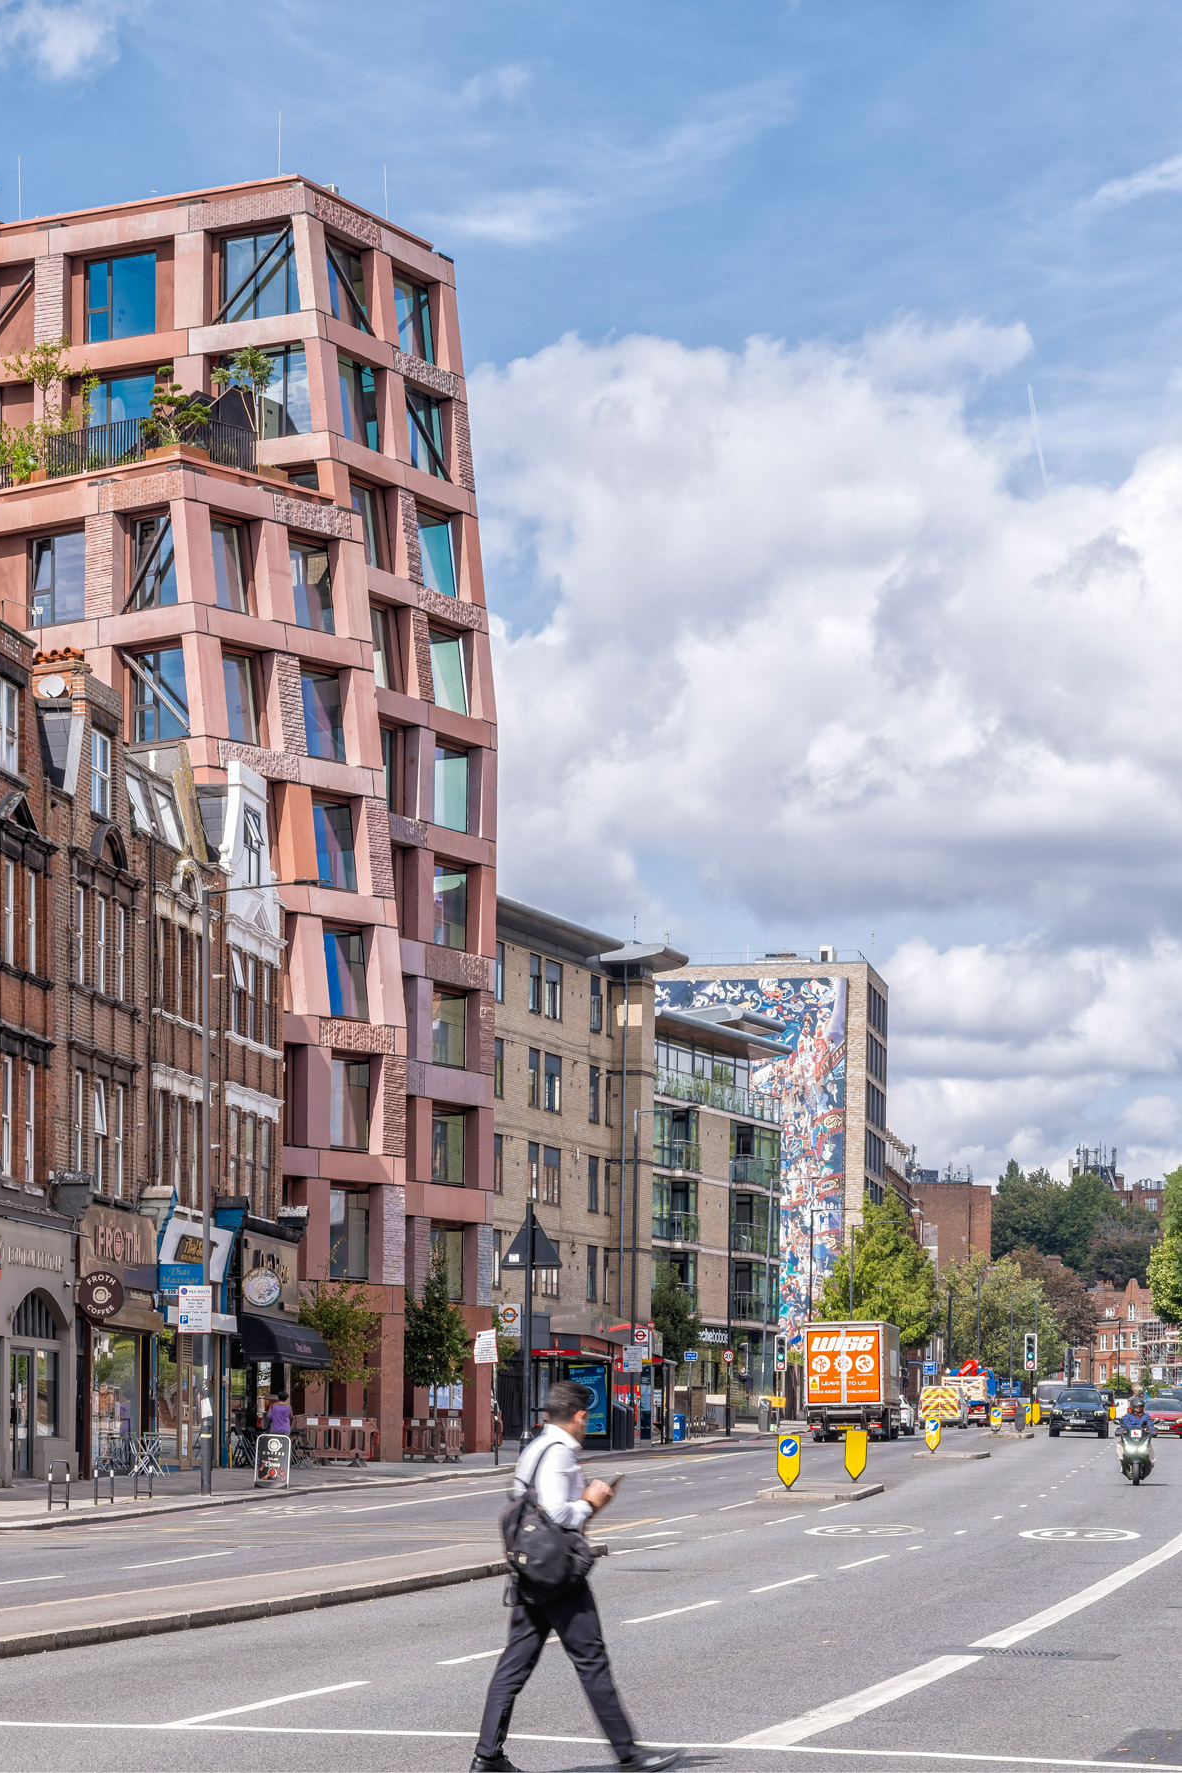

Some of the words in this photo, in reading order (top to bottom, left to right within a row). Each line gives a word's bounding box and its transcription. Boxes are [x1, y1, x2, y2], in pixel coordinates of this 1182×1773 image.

[95, 1225, 141, 1262] FROTH
[169, 1267, 191, 1276] Thai
[86, 1274, 117, 1286] FROTH
[160, 1275, 200, 1286] Massage
[86, 1304, 115, 1315] COFFEE
[810, 1335, 876, 1352] WISE
